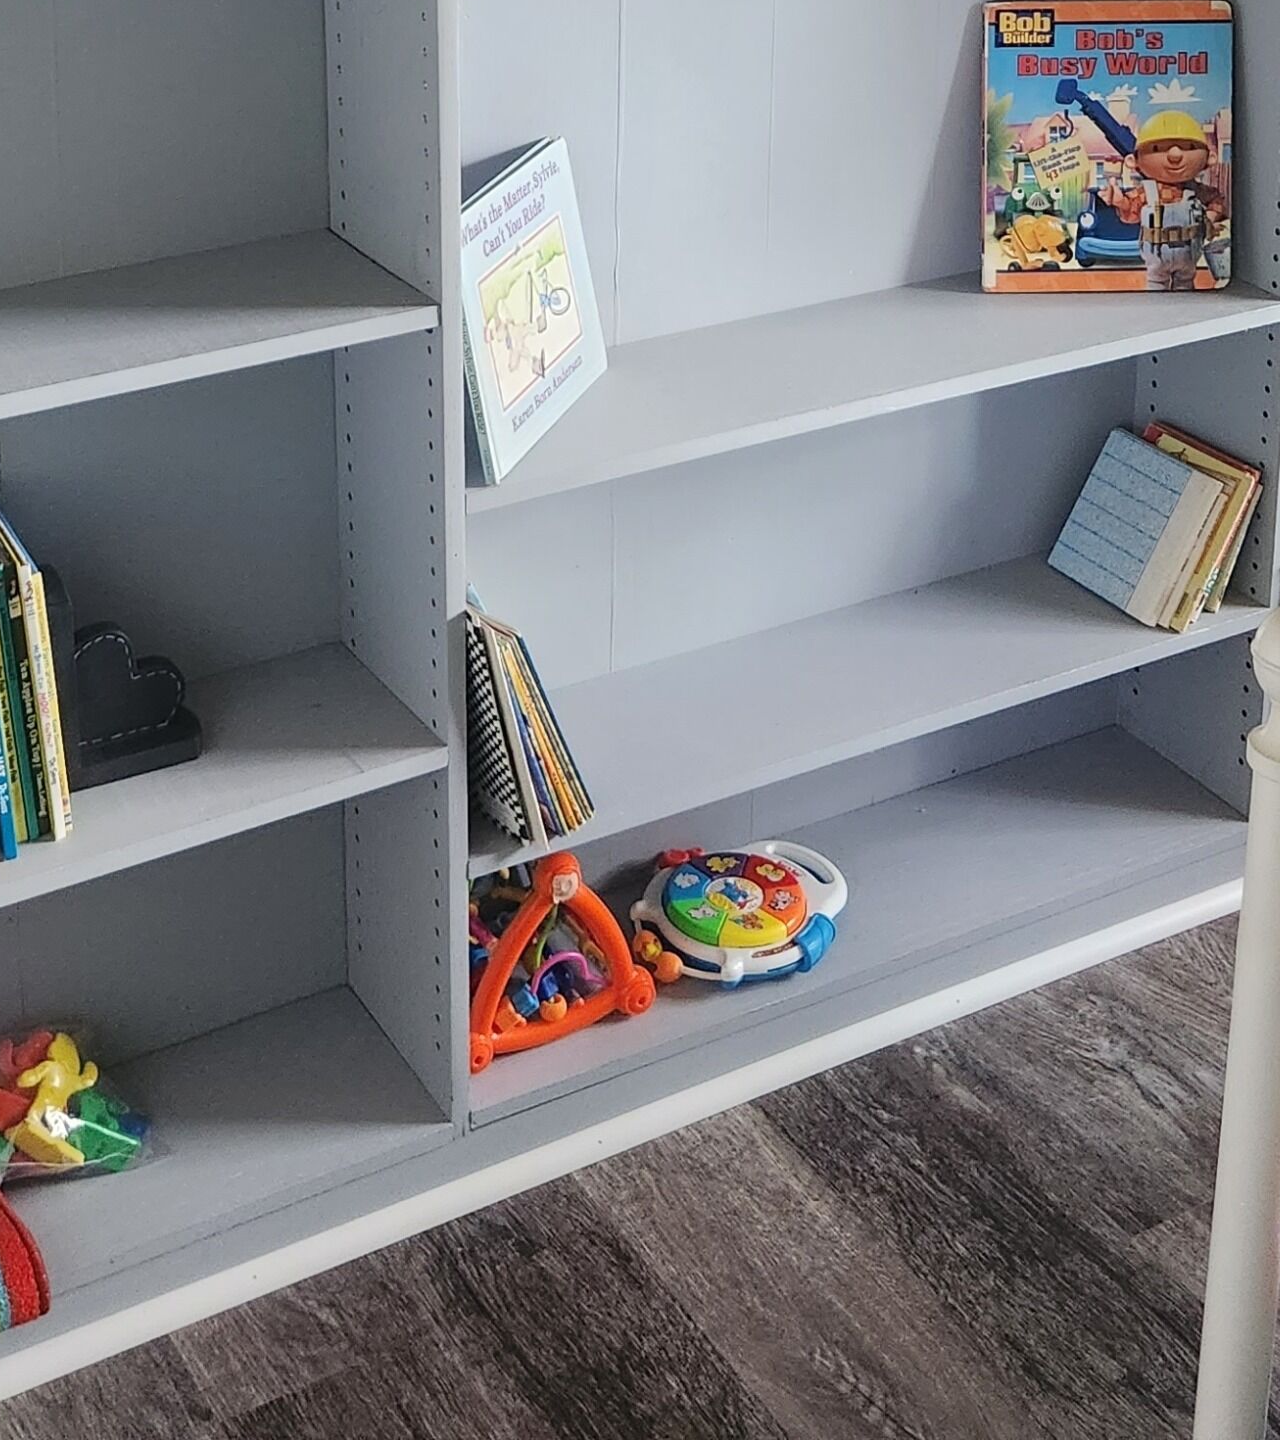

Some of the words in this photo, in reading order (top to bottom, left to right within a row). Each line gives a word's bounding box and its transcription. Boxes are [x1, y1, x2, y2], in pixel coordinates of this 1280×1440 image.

[1000, 11, 1051, 32] Bob
[1003, 32, 1053, 44] Builder
[1076, 28, 1164, 50] Bob's
[1017, 54, 1097, 79] Busy
[1105, 51, 1208, 75] World
[1045, 169, 1058, 181] 43
[488, 203, 503, 224] the
[483, 227, 506, 257] Can't
[505, 219, 523, 239] You
[522, 193, 545, 226] Ride?
[18, 658, 29, 679] Ten
[19, 680, 34, 714] Apples
[25, 713, 37, 729] Up
[28, 728, 39, 744] On
[29, 744, 42, 768] Top!
